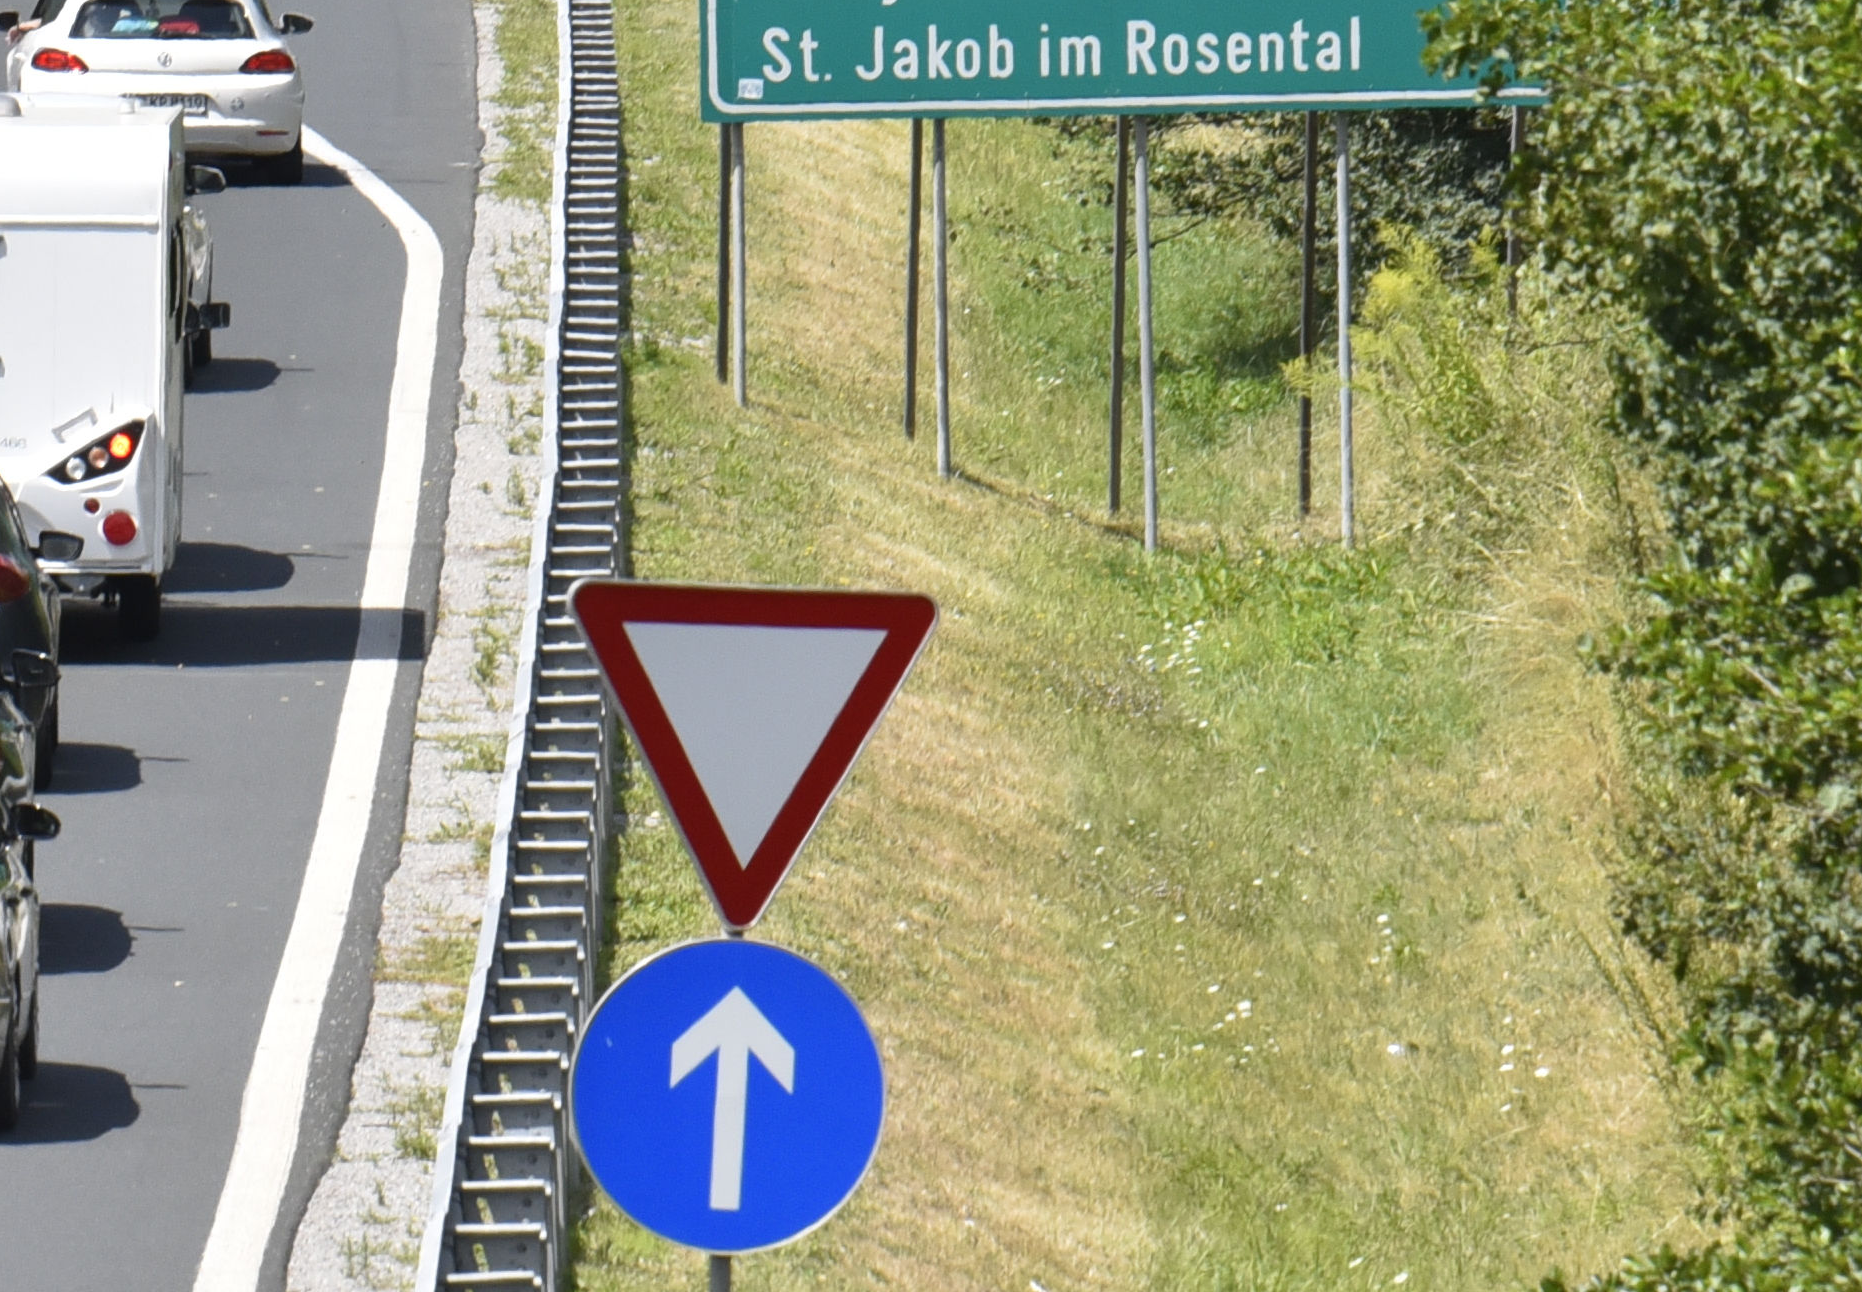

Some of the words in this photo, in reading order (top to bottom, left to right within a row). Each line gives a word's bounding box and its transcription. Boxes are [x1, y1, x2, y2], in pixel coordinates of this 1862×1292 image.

[762, 26, 833, 84] St.
[856, 23, 1016, 82] Jakob
[1041, 22, 1102, 78] im
[1126, 15, 1363, 75] Rosental
